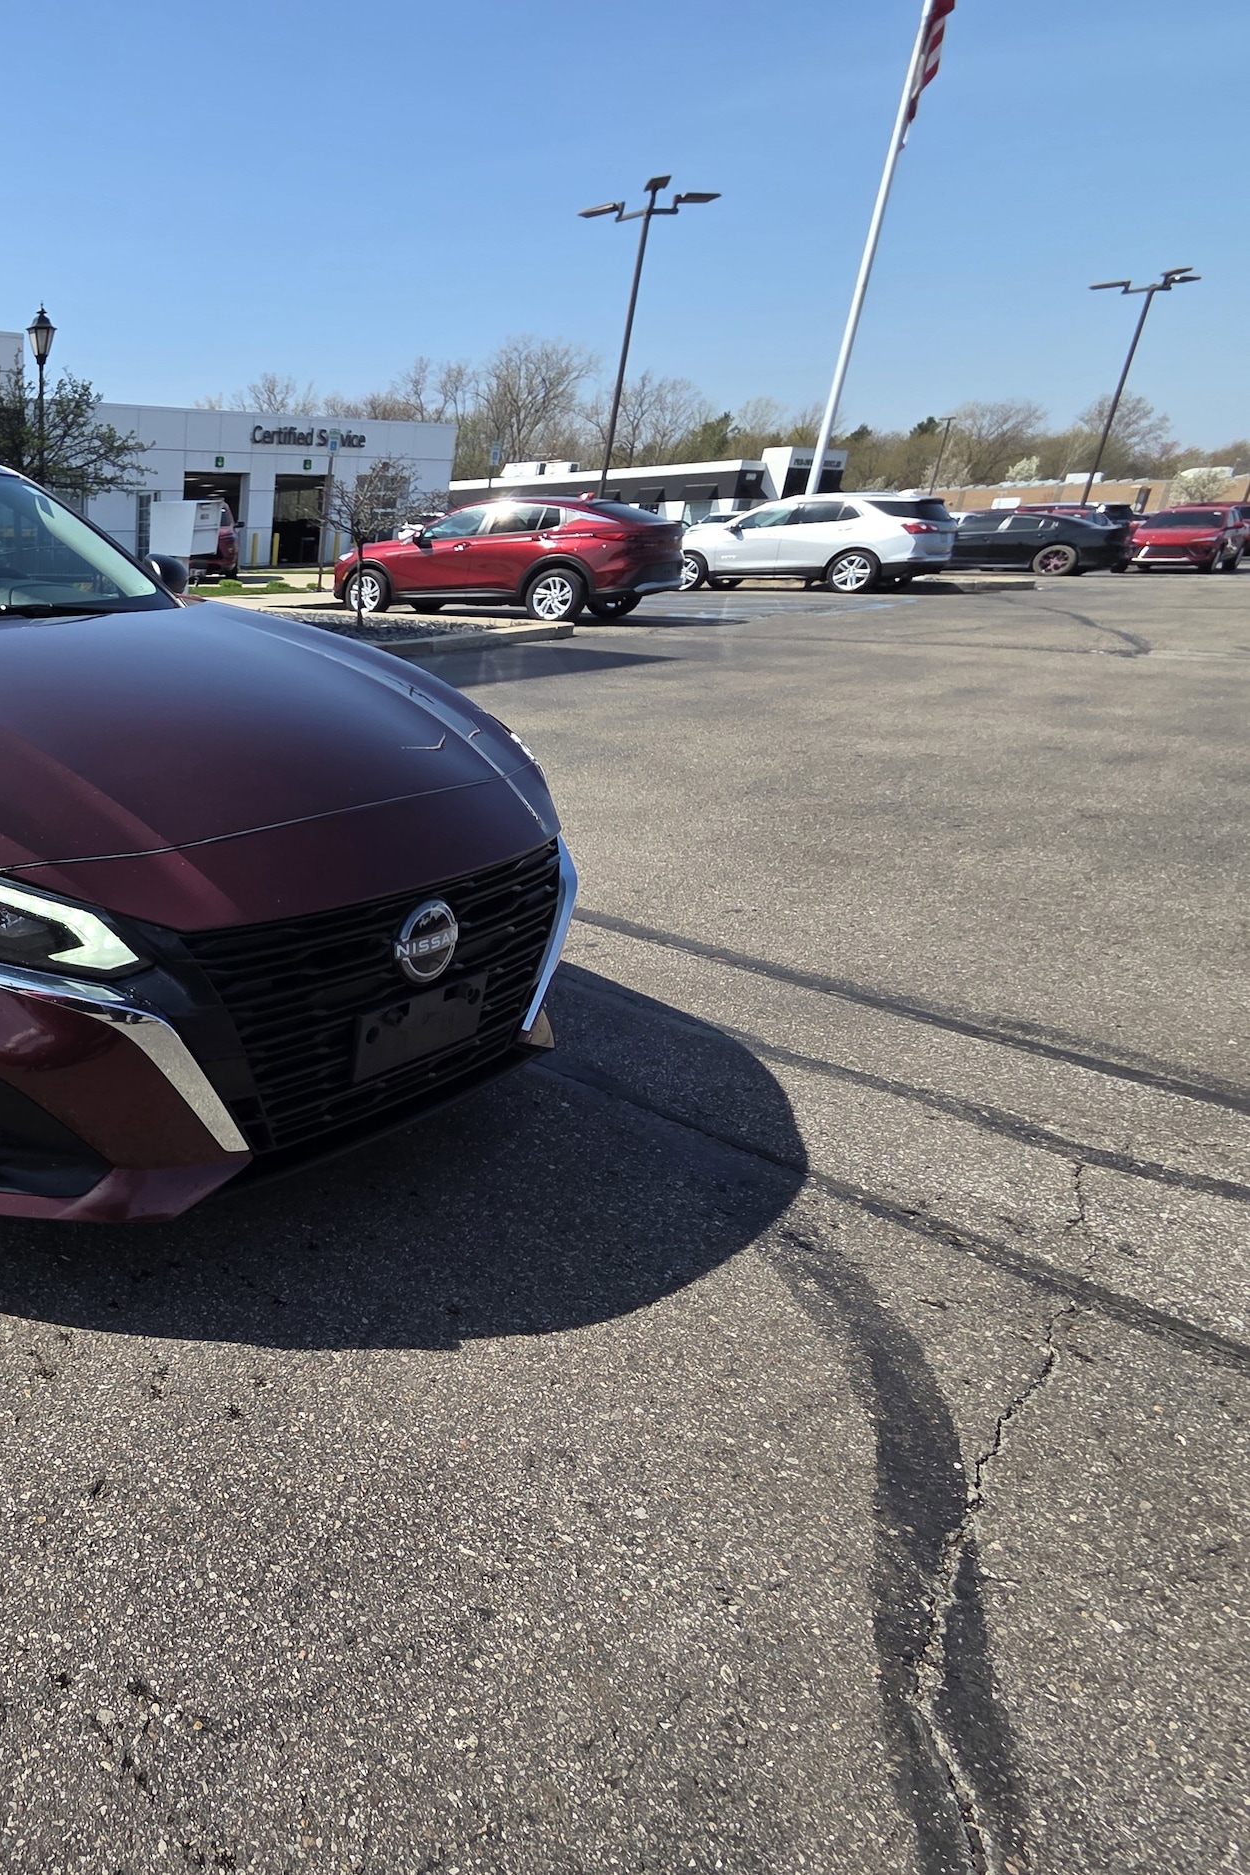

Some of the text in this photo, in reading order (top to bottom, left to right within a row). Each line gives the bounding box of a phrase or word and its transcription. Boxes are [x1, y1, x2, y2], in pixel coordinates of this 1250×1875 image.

[251, 425, 314, 447] Certified
[316, 428, 366, 448] Svice
[396, 929, 458, 958] NISSAN
